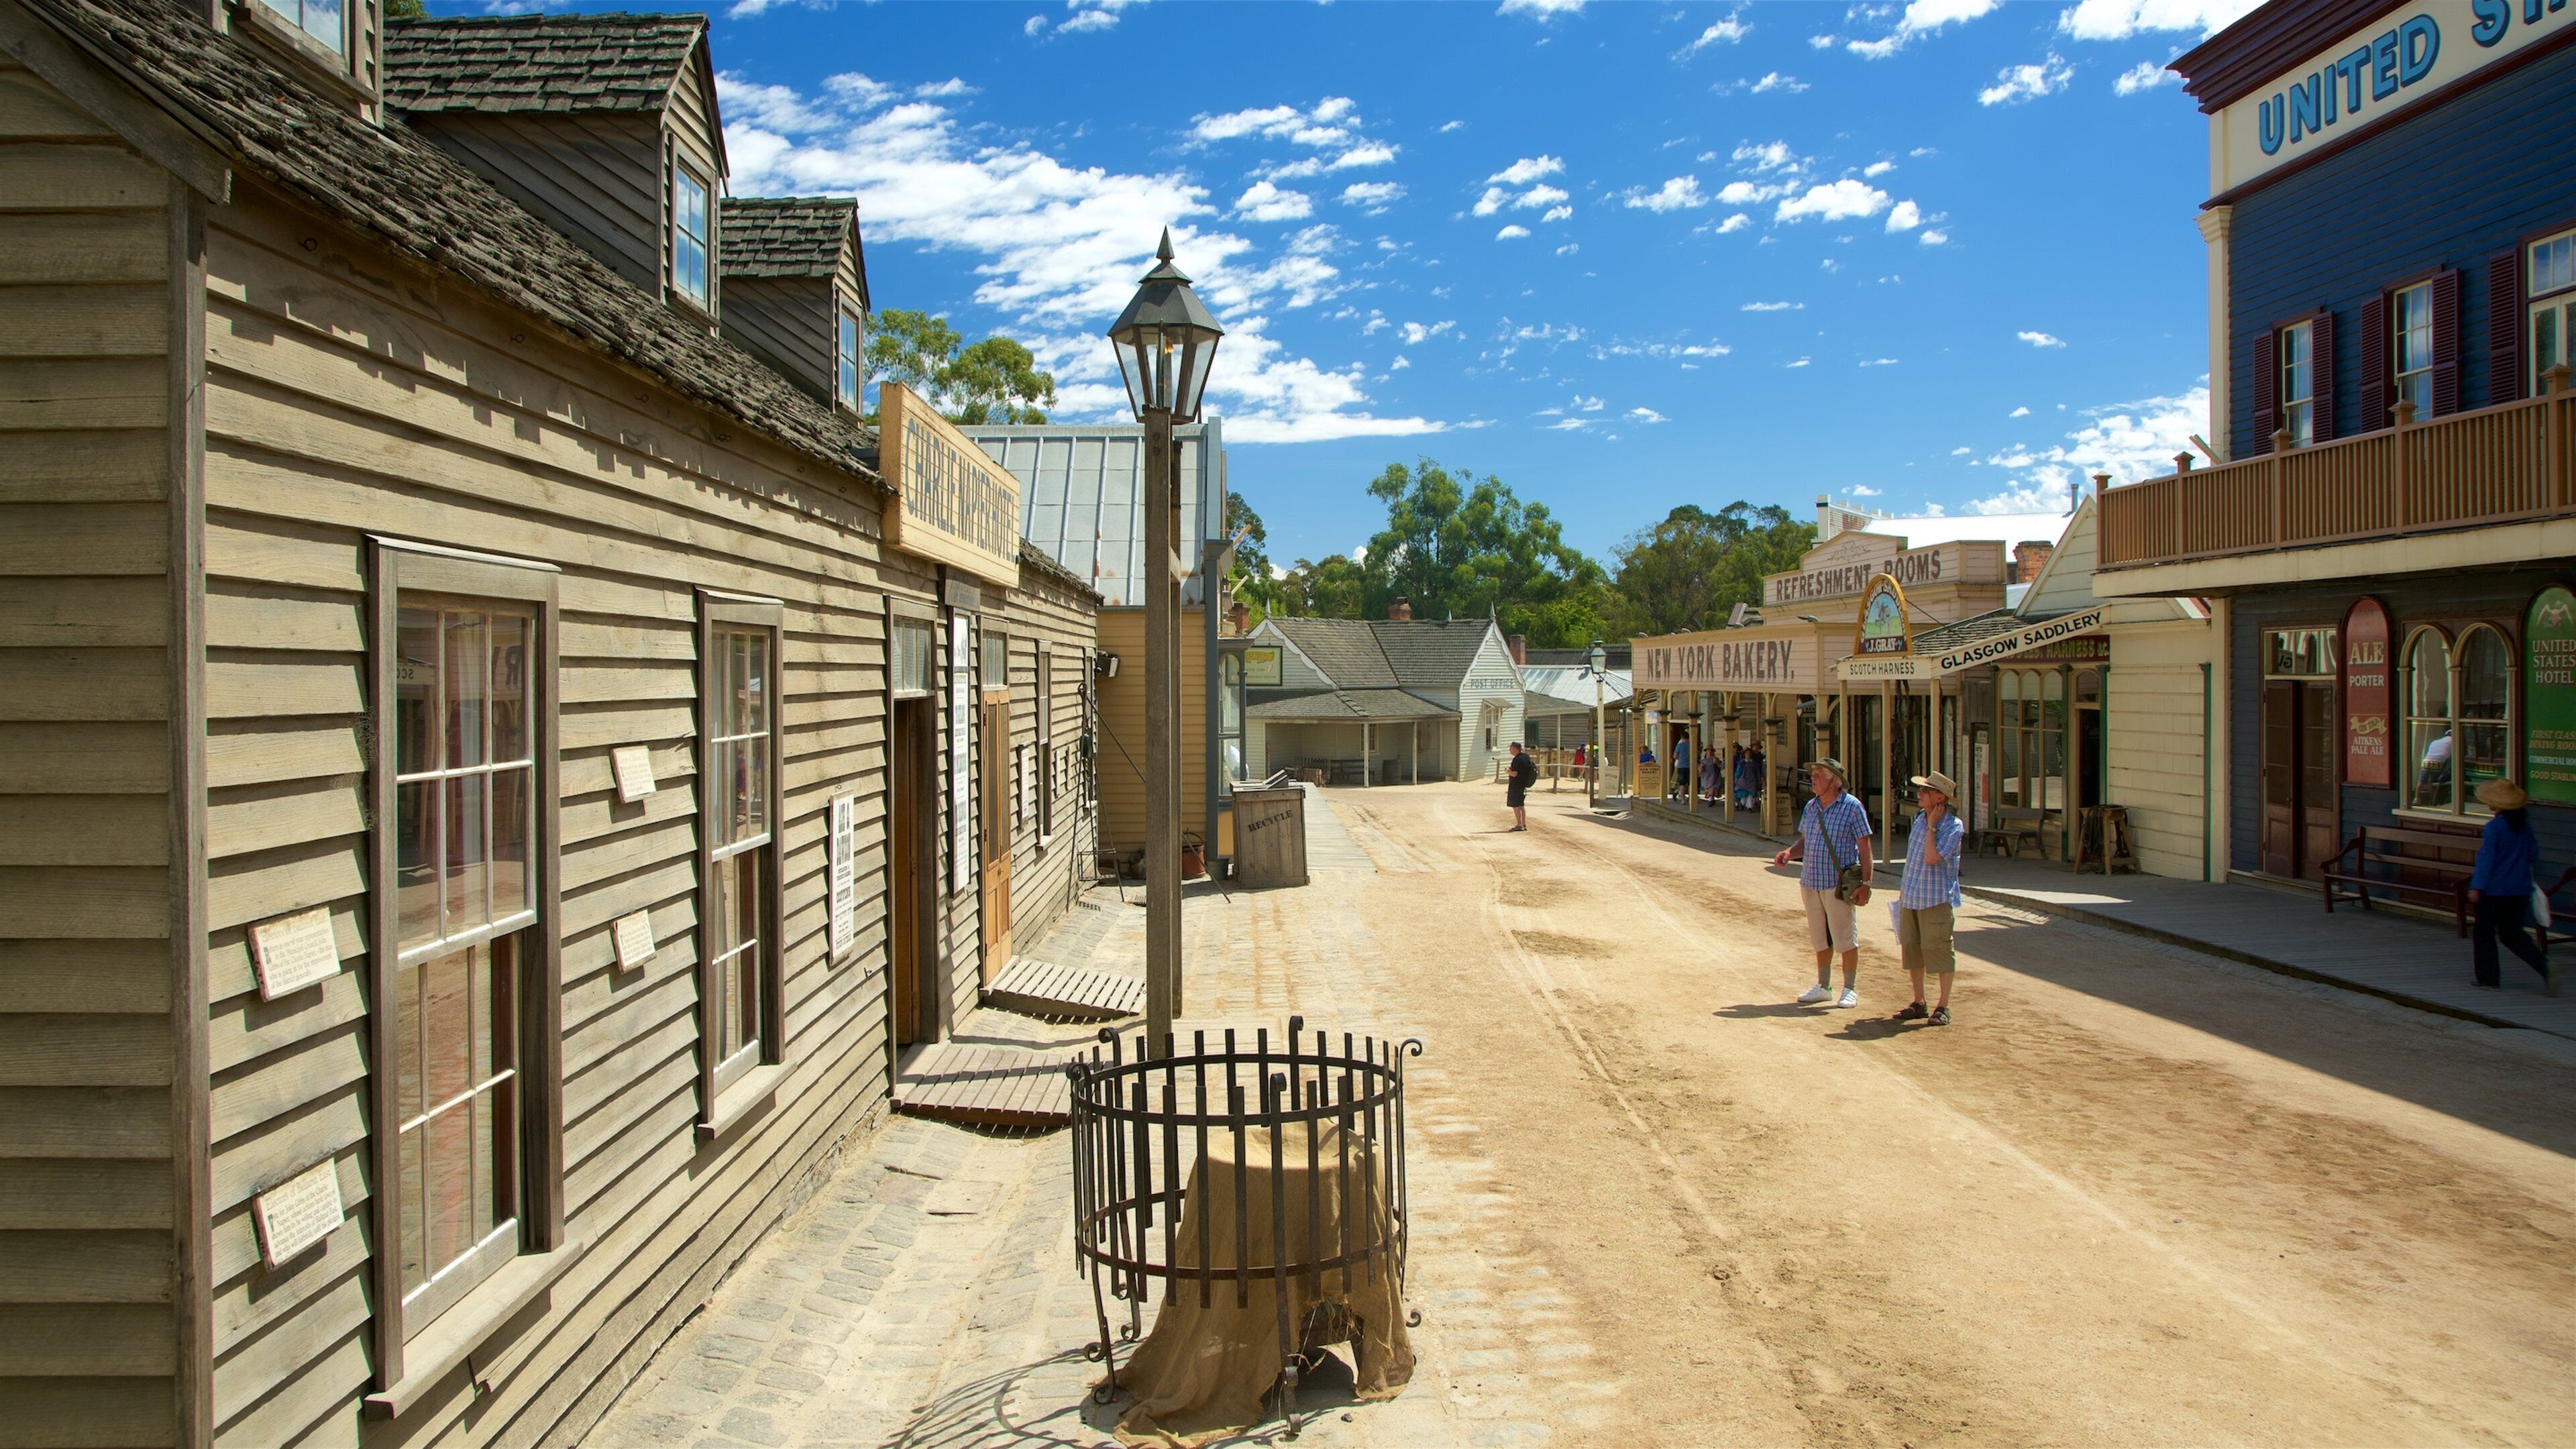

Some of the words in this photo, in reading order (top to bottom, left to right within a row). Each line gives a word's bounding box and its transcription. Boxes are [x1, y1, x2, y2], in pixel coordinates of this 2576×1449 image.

[2259, 13, 2440, 156] UNITED
[904, 417, 957, 536] CHARLIE
[958, 455, 991, 553] NAPIER
[992, 480, 1016, 564] HOTEL
[1776, 563, 1872, 601] REFRESHMENT
[1884, 549, 1941, 584] ROOMS
[1941, 636, 2019, 669] GLASGOW
[2024, 611, 2102, 645] SADDLERY
[2532, 639, 2576, 653] UNITED
[2046, 639, 2095, 659] HARNESS
[2348, 641, 2385, 665] ALE
[1647, 647, 1672, 680] NEW
[1678, 645, 1715, 679] YORK
[1849, 663, 1876, 675] SCOTCH
[1878, 661, 1915, 675] HARNESS
[2533, 655, 2576, 667] STATES
[1470, 679, 1488, 688] POST
[1491, 679, 1514, 688] OFFICE
[2349, 674, 2384, 687] PORTER
[2536, 670, 2575, 684] HOTEL
[2353, 737, 2382, 745] AITKENS
[2351, 745, 2368, 755] PALE
[2370, 746, 2384, 755] ALE
[2530, 770, 2550, 780] GOOD
[1248, 810, 1293, 832] RECYCLE
